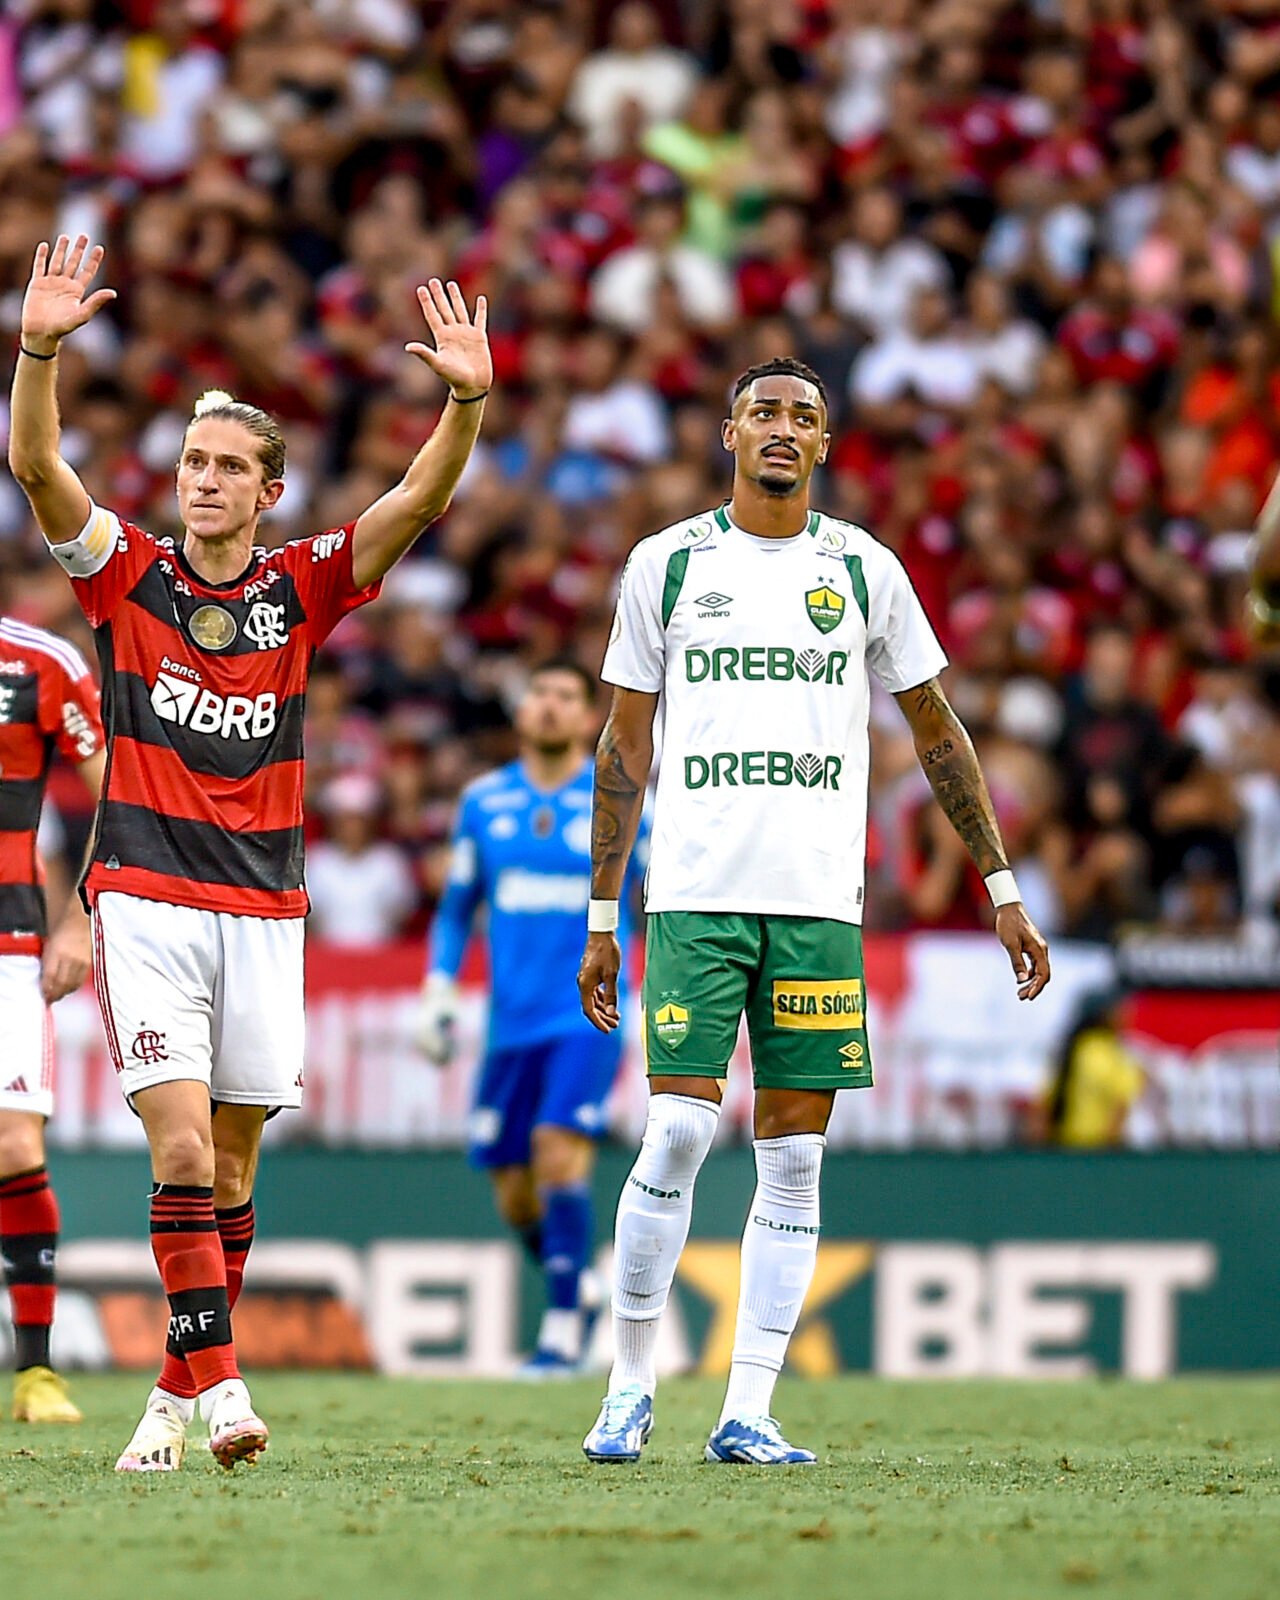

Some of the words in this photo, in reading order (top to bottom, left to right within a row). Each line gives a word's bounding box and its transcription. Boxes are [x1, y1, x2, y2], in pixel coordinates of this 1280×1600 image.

[697, 610, 731, 619] umbro
[685, 647, 848, 686] DREBOR
[189, 688, 277, 740] BRB
[684, 751, 841, 791] DREBOR
[777, 993, 818, 1015] SEJA
[876, 1240, 1216, 1379] BET
